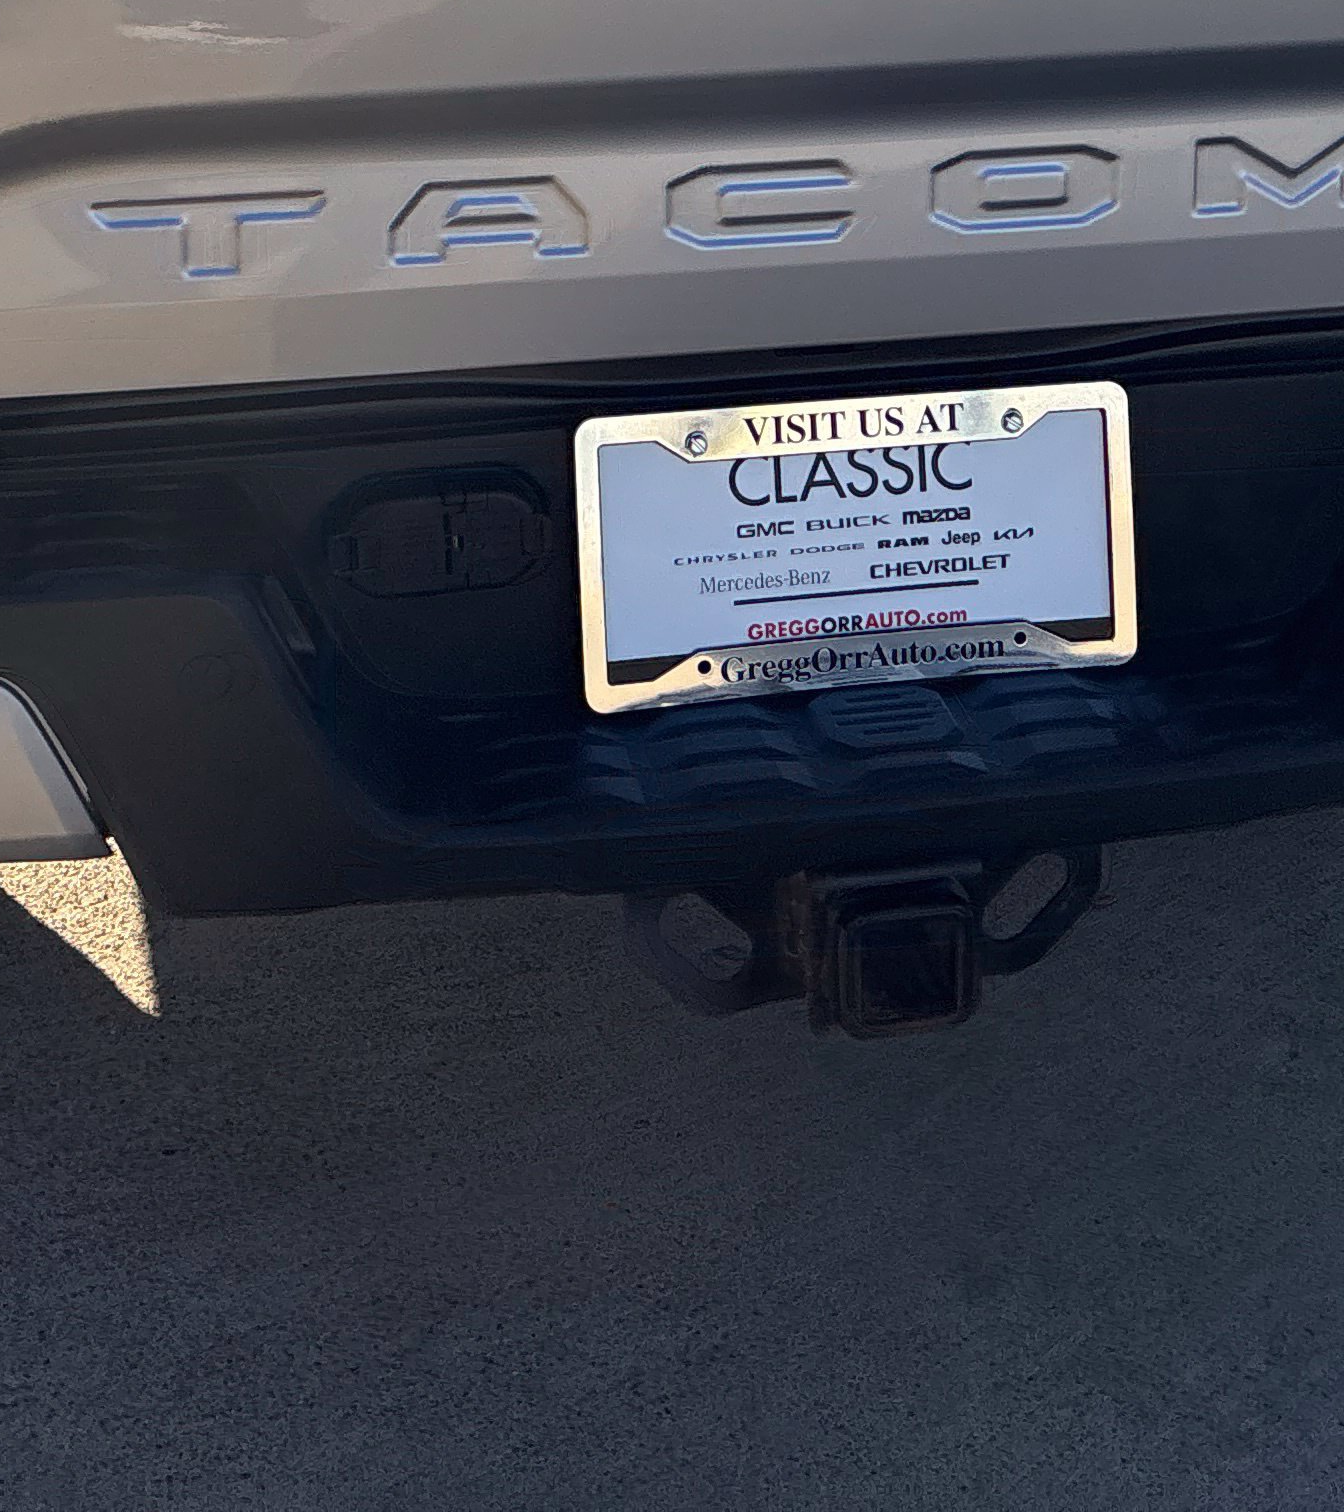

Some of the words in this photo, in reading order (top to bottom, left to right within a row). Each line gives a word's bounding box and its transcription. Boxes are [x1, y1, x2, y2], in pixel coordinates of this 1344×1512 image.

[743, 411, 846, 446] VISIT
[859, 406, 905, 438] US
[916, 402, 964, 434] AT
[728, 442, 973, 507] CLASSIC
[736, 520, 795, 539] GMC
[806, 513, 892, 532] BUICK
[673, 549, 778, 567] CHRYSLER
[790, 541, 865, 556] DODGE
[877, 536, 929, 549] RAM
[941, 530, 982, 546] Jeep
[699, 568, 832, 595] Mercedes-Benz
[869, 553, 1011, 580] CHEVROLET
[748, 609, 968, 640] GREGGORRAUTO.com
[721, 640, 1005, 684] GreggOrrAuto.com
